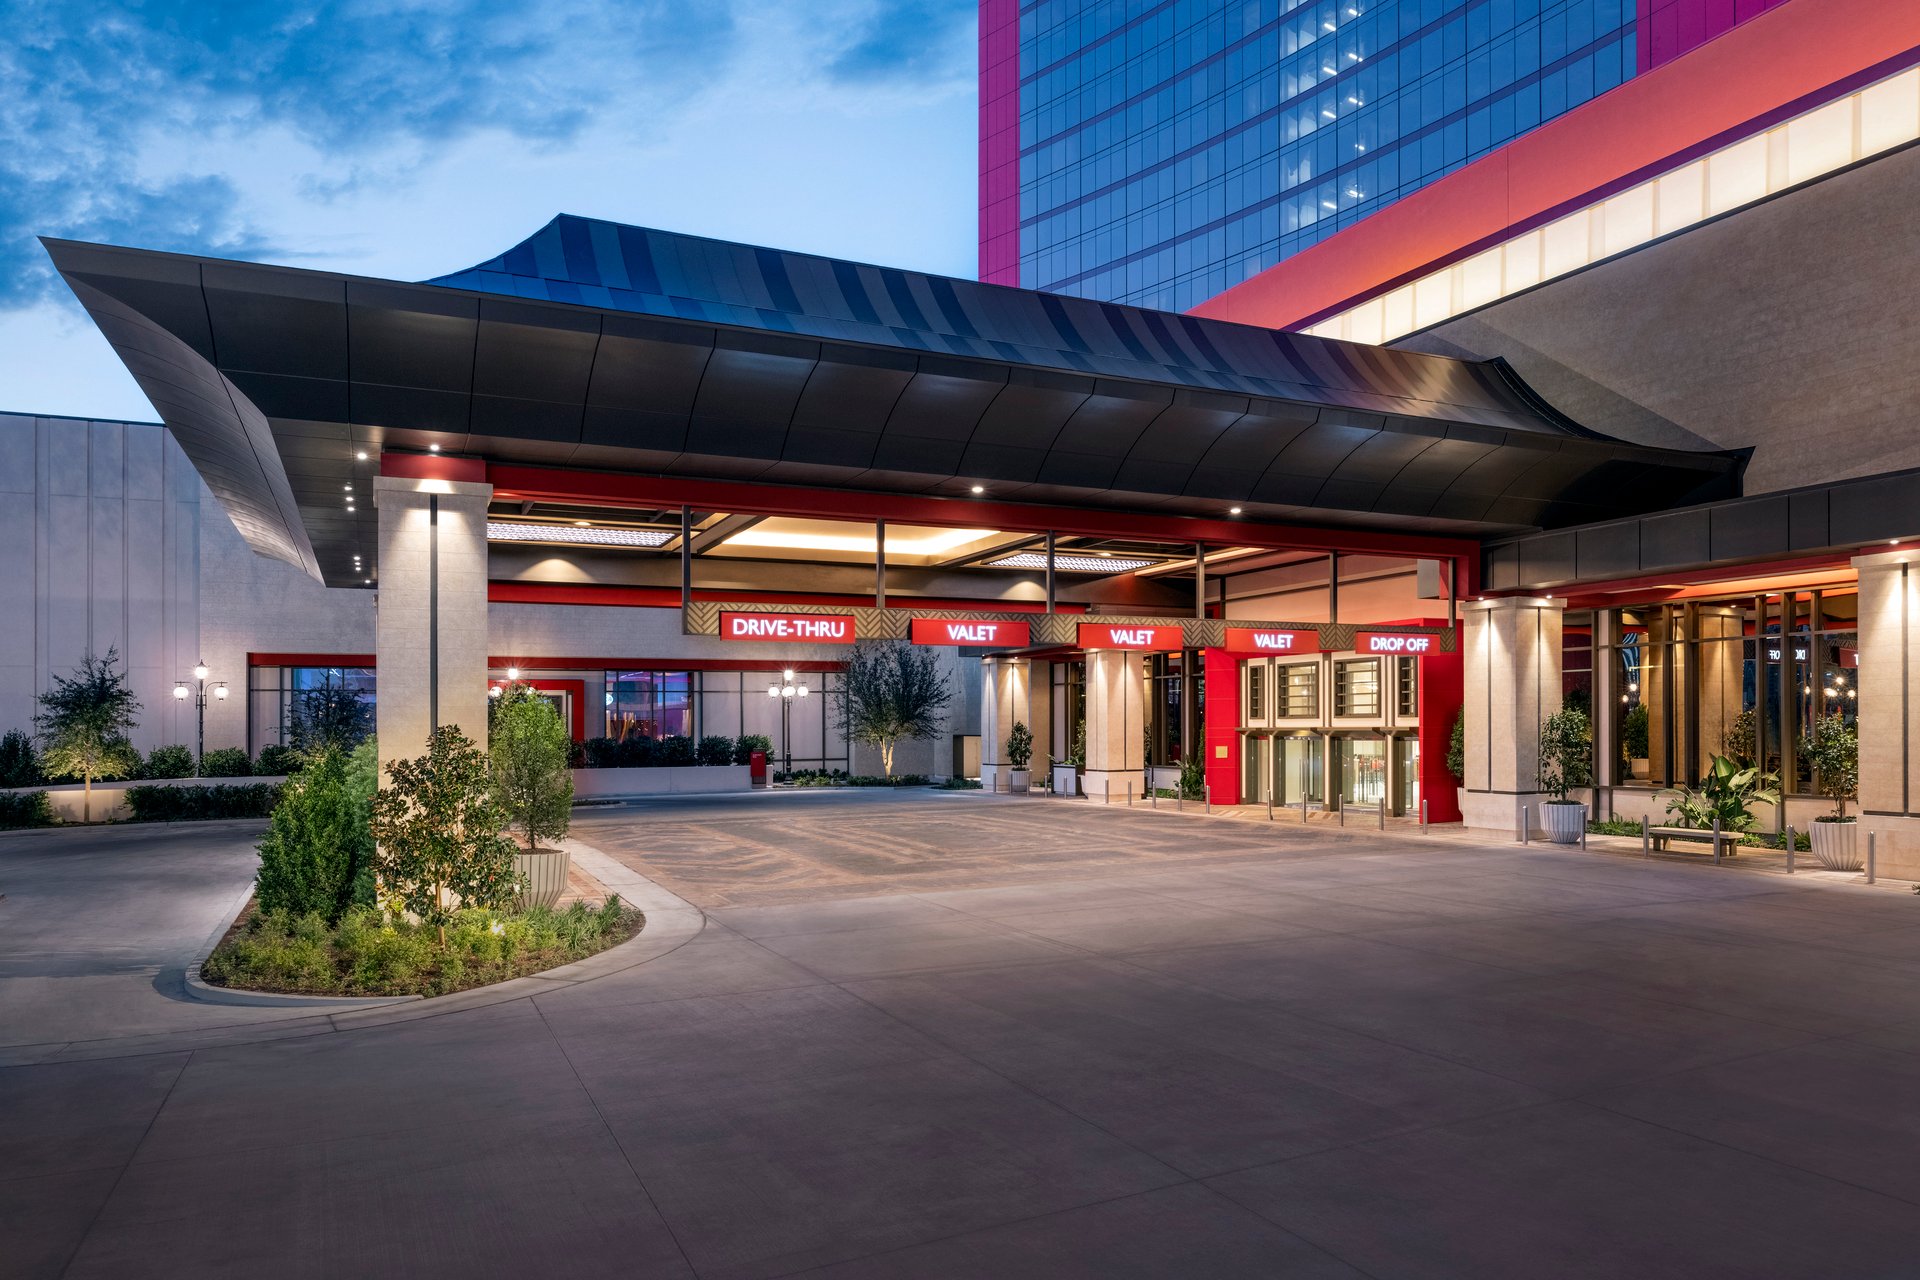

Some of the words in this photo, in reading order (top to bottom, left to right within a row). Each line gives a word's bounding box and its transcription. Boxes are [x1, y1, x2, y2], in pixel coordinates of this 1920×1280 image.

[733, 618, 845, 637] DRIVE-THRU
[947, 624, 997, 641] VALET
[1110, 629, 1154, 645] VALET
[1254, 633, 1294, 649] VALET
[1371, 636, 1404, 651] DROP
[1405, 638, 1429, 652] OFF
